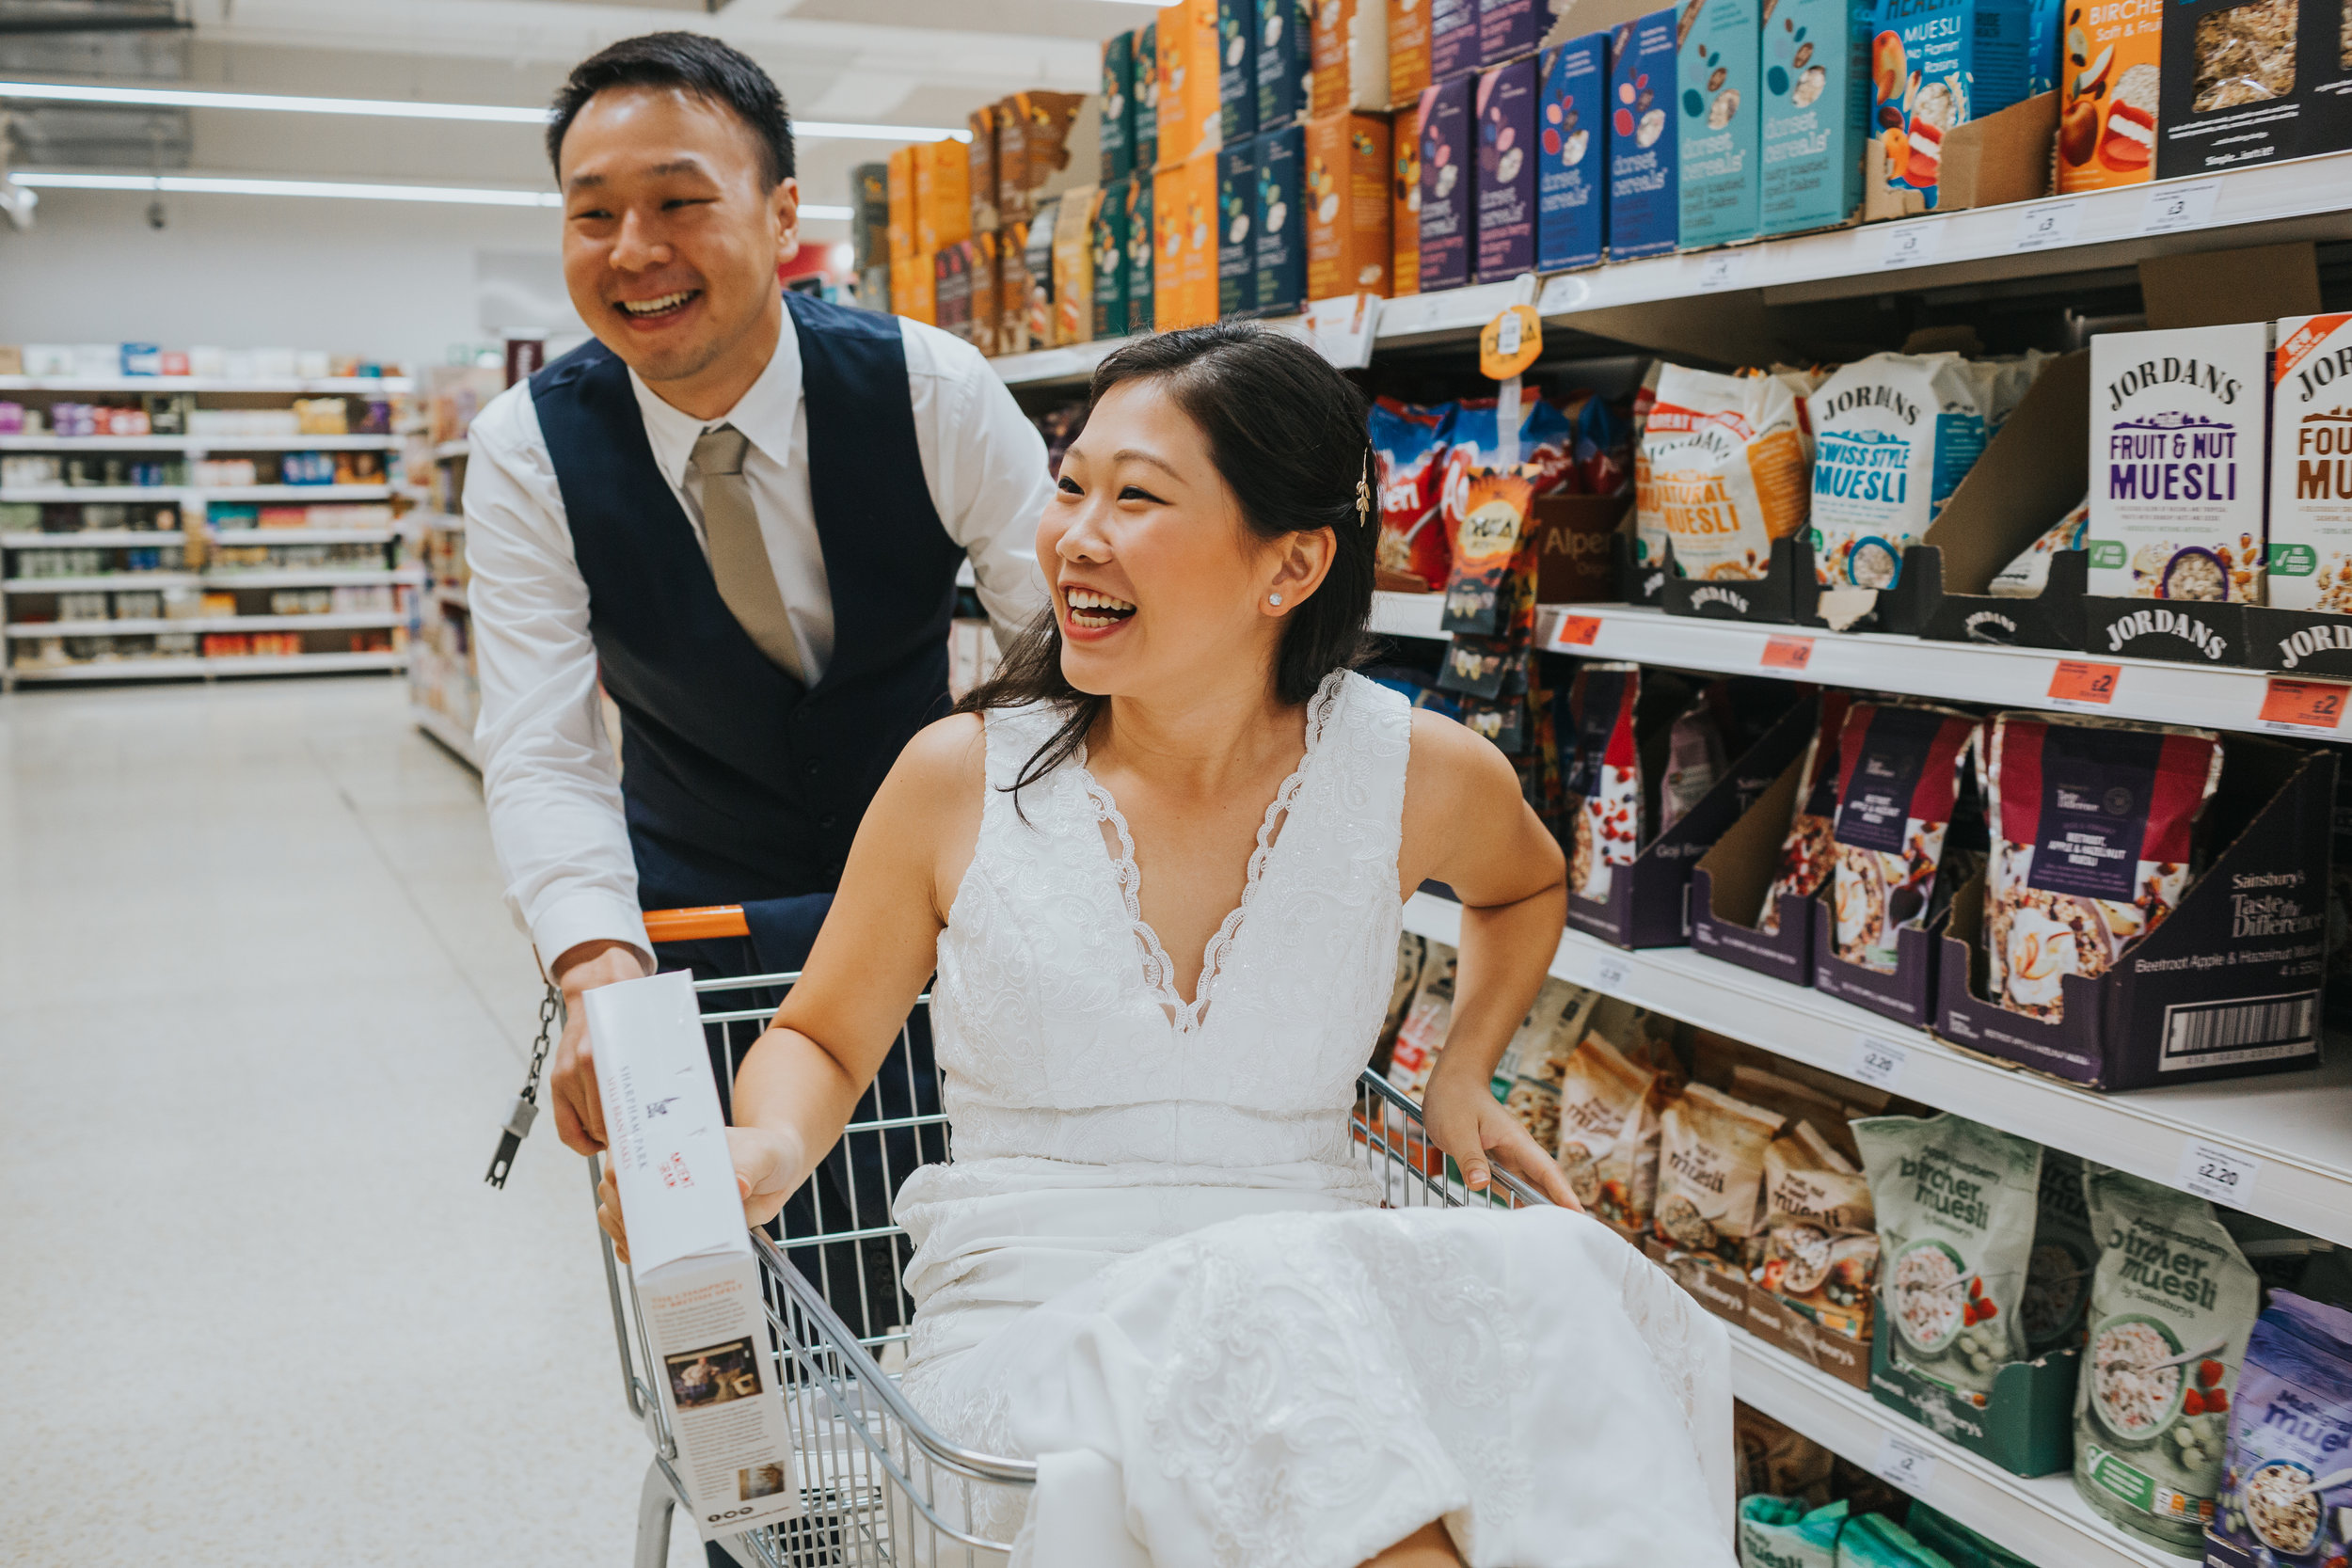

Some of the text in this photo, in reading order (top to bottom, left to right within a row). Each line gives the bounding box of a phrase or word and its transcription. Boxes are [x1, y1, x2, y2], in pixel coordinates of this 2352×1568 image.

[1904, 15, 1962, 43] MUESLI
[2107, 356, 2244, 412] JORDANS
[2110, 432, 2237, 460] FRUIT & NUT
[1815, 465, 1907, 504] MUESLI
[2109, 463, 2237, 500] MUESLI
[2106, 609, 2229, 660] JORDANS
[2091, 674, 2113, 692] £2
[2312, 695, 2339, 715] £2
[2231, 870, 2306, 891] Sainsbury's
[1899, 1154, 1982, 1203] bircher
[2198, 1163, 2239, 1186] £2.20
[1915, 1182, 1991, 1231] muesli
[2118, 1256, 2218, 1311] muesli
